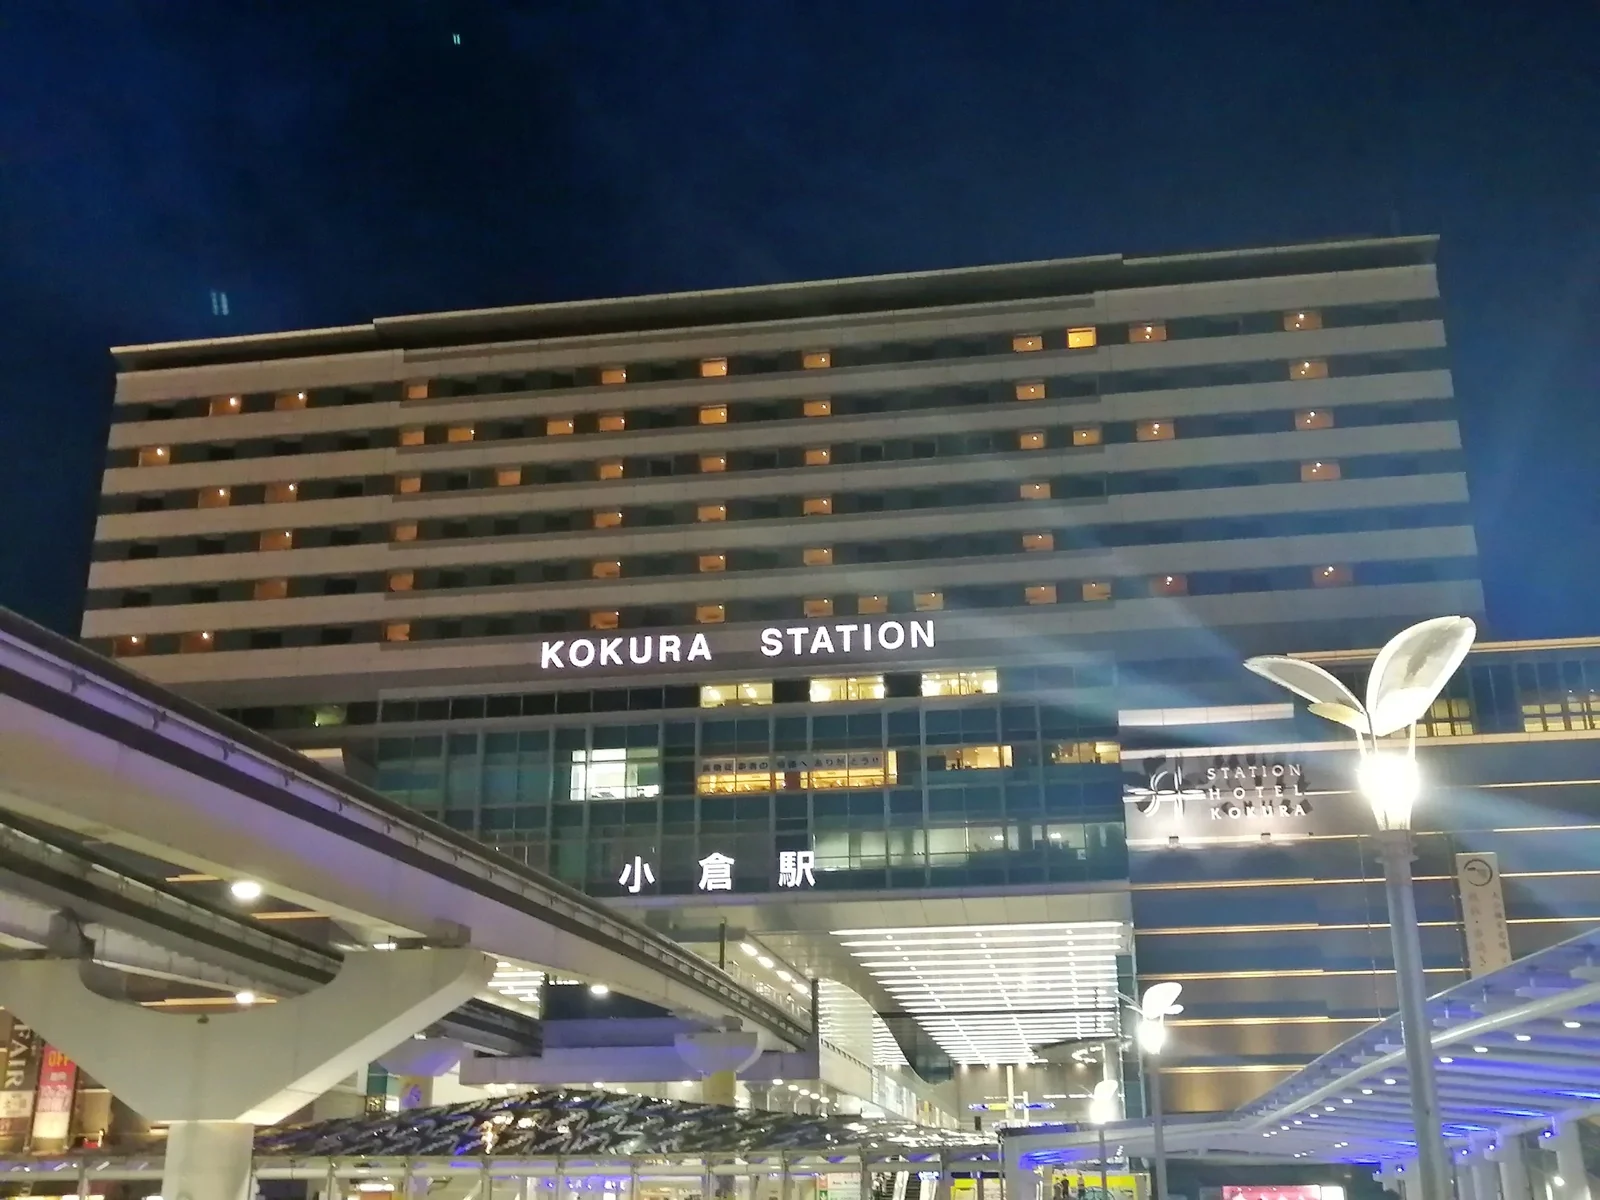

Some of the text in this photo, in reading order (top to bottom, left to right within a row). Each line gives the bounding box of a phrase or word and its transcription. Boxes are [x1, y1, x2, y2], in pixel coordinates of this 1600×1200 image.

[540, 619, 936, 669] KOKURA STATION
[1207, 764, 1301, 780] STATION
[1209, 785, 1303, 800] HOTEL
[1211, 804, 1306, 820] KOKURA
[618, 851, 816, 893] 小倉駅
[4, 1024, 30, 1088] FAIR
